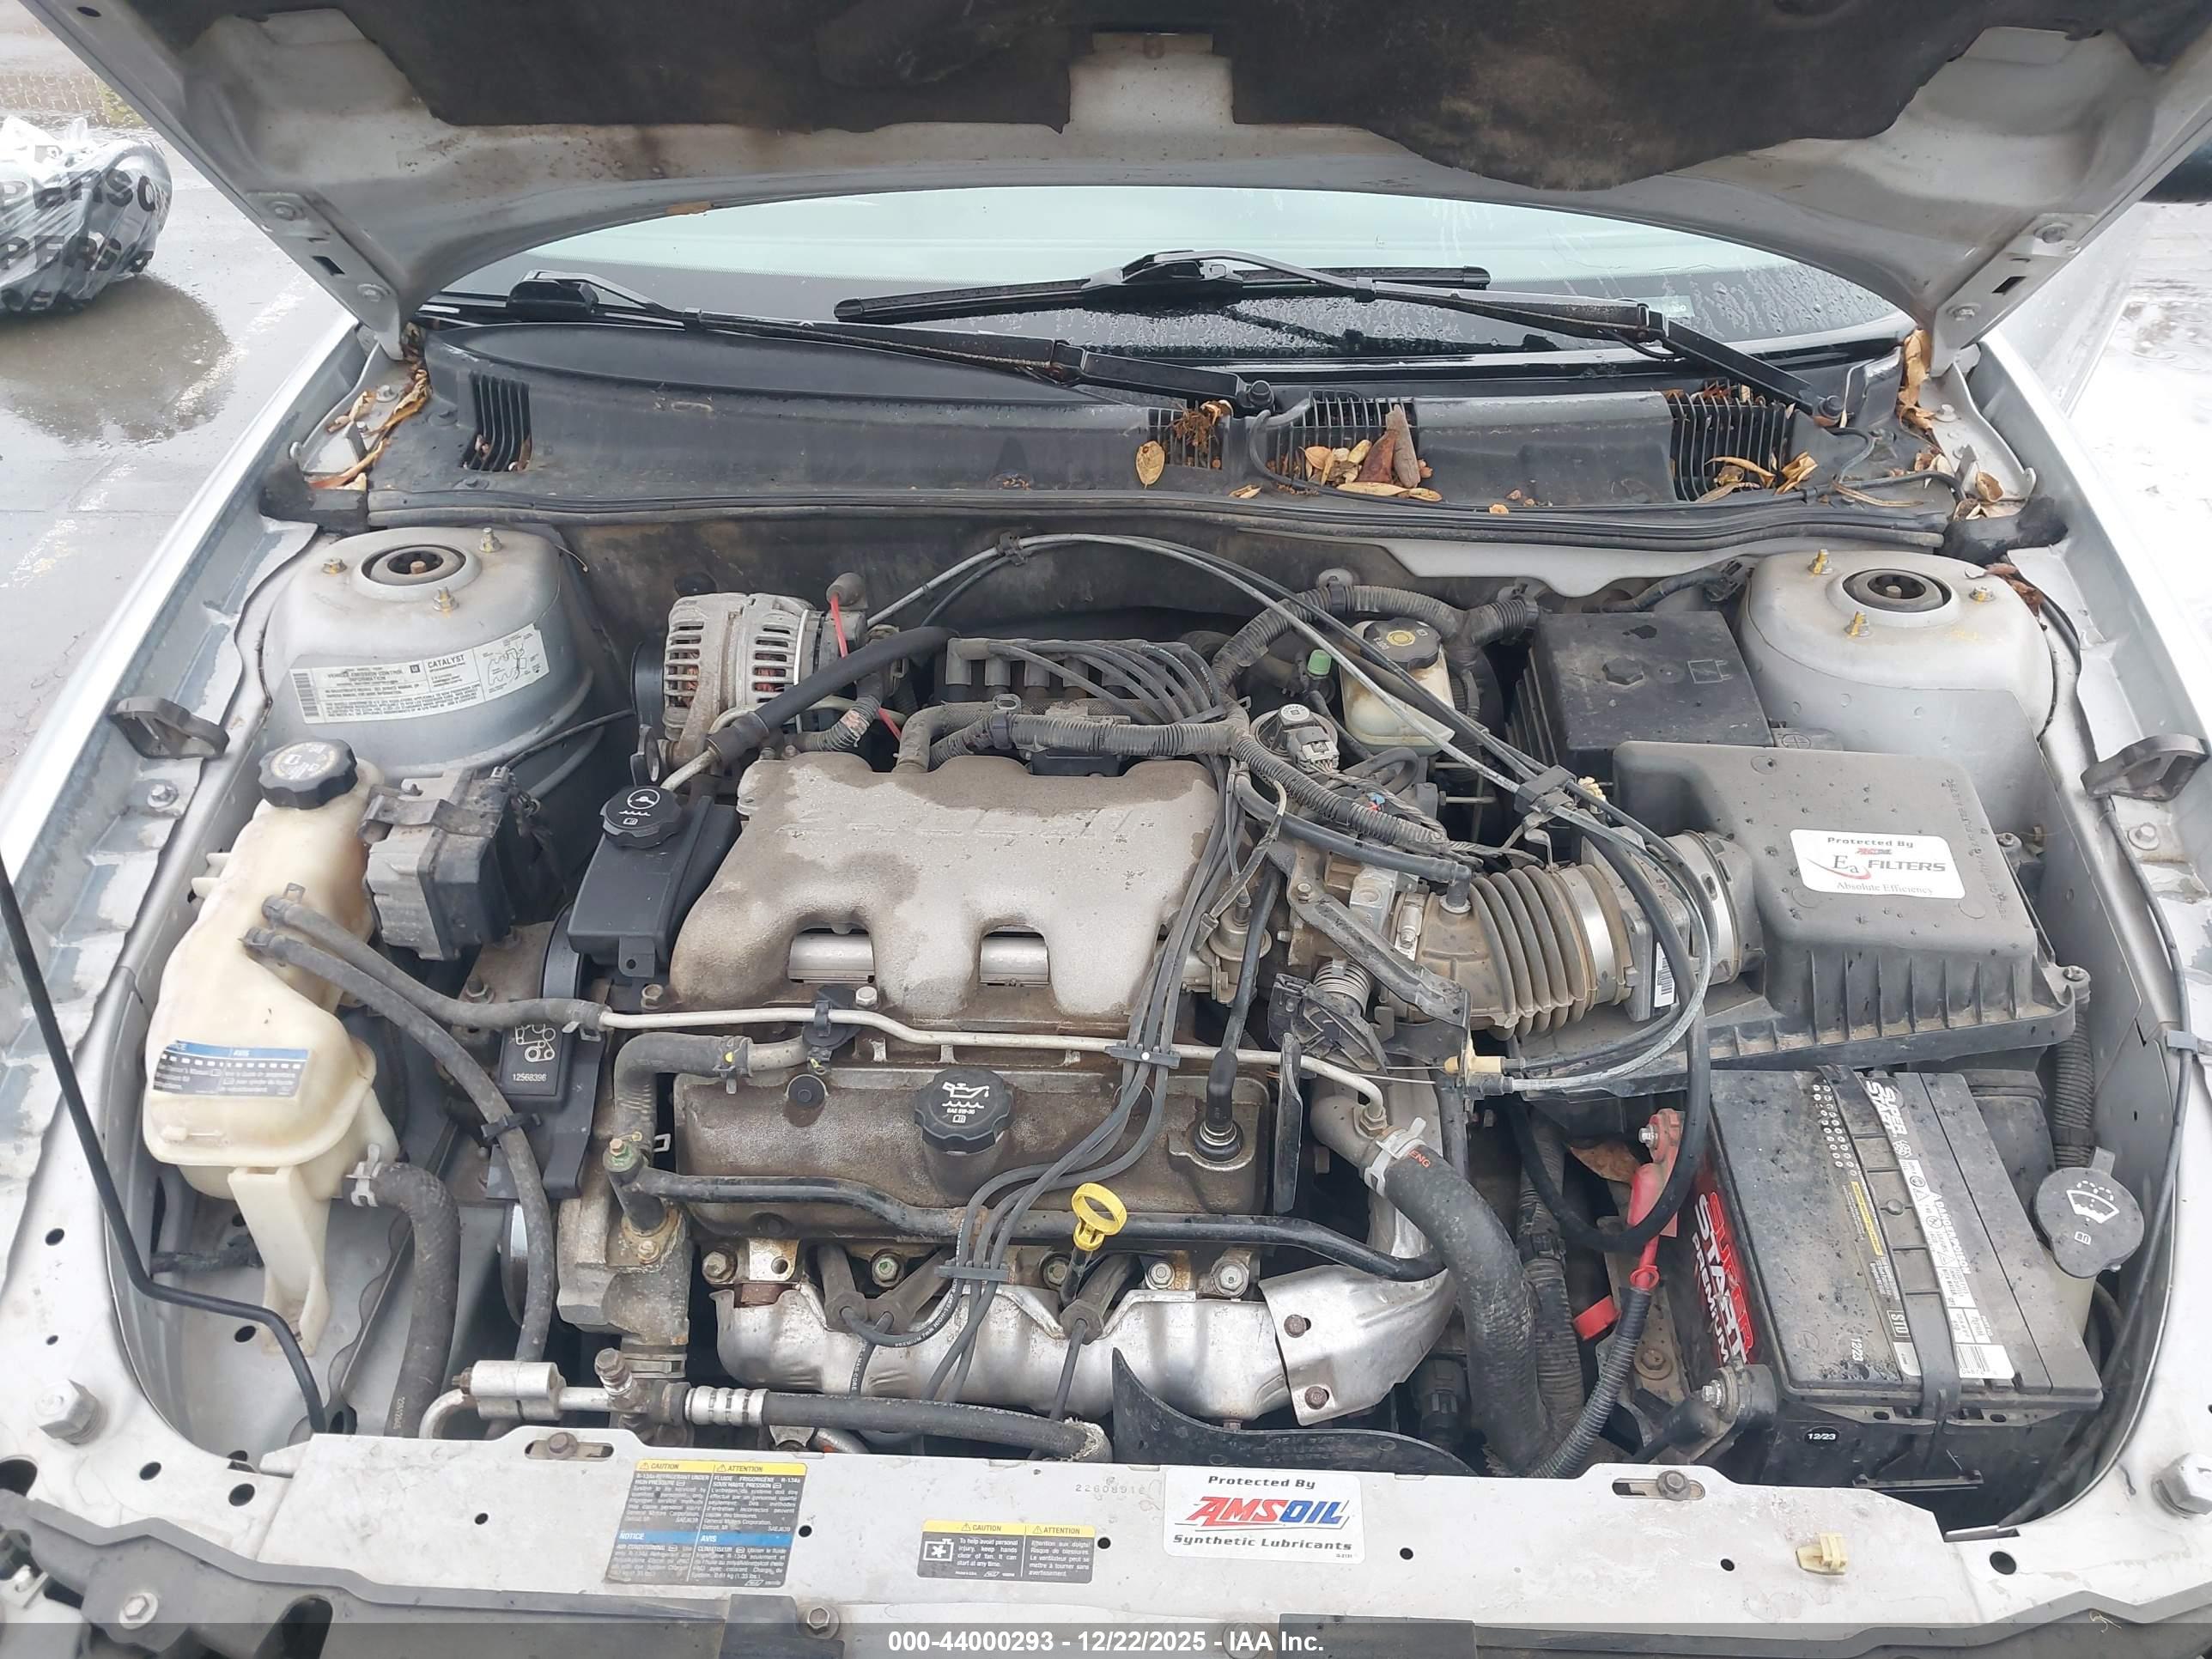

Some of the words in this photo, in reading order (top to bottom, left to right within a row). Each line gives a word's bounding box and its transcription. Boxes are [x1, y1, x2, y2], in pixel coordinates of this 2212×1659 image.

[428, 654, 465, 669] CATALYST
[1827, 837, 1893, 846] Protected
[1898, 839, 1914, 848] By
[1869, 860, 1946, 872] FILTERS
[1837, 882, 1881, 891] Absolute
[1883, 884, 1933, 896] Efficiency
[513, 1073, 547, 1082] 12568396
[1866, 1080, 1896, 1135] START
[1883, 1086, 1908, 1135] SUPER
[1409, 1150, 1431, 1169] ENG
[1695, 1193, 1747, 1364] START
[1710, 1192, 1754, 1354] SUPER
[1692, 1231, 1729, 1364] PREMIUM
[1891, 1313, 1909, 1334] STD
[1850, 1338, 1864, 1361] 12/23
[1208, 1476, 1291, 1489] Protected
[1296, 1479, 1316, 1490] By
[1185, 1497, 1343, 1527] AMSOIL
[1173, 1534, 1255, 1547] Synthetic
[1261, 1538, 1352, 1551] Lubricants
